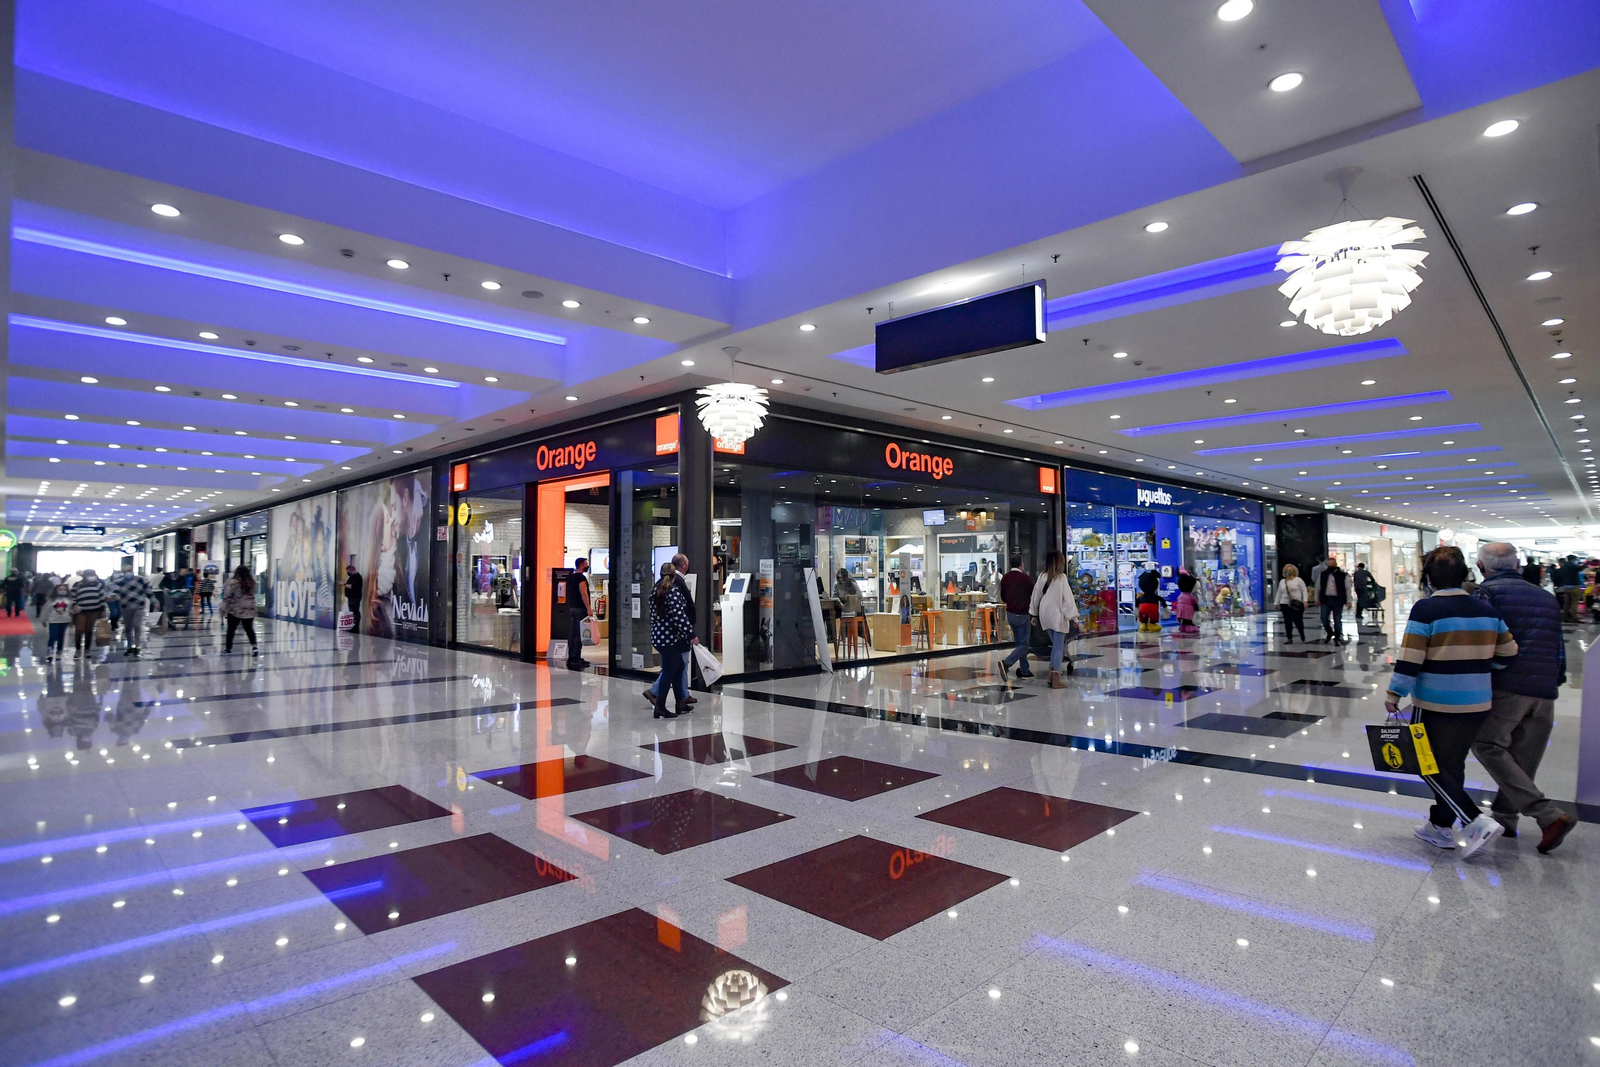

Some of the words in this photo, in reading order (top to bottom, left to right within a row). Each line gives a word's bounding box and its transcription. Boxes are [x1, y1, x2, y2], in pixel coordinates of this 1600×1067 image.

[536, 440, 597, 471] Orange
[656, 441, 677, 452] orange
[716, 440, 742, 452] orange
[885, 442, 954, 480] Orange
[1137, 482, 1172, 507] juguettos
